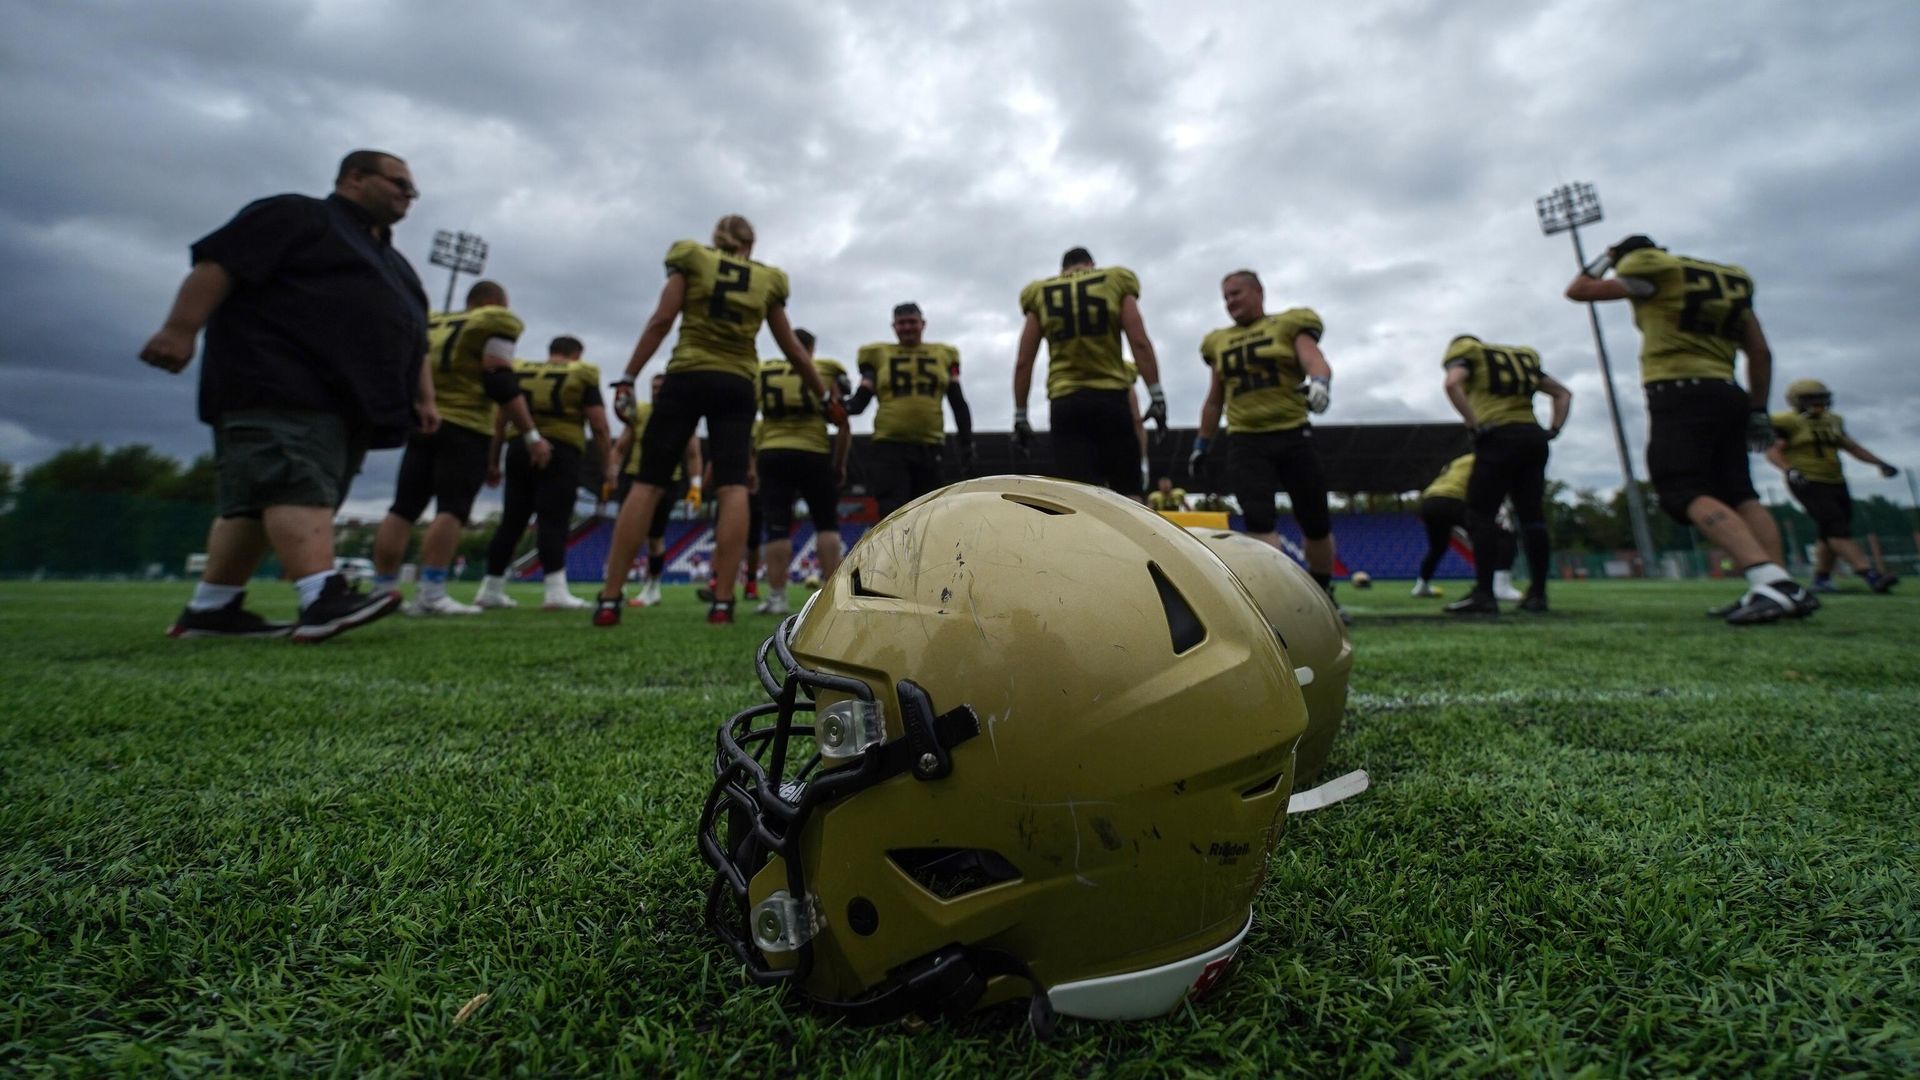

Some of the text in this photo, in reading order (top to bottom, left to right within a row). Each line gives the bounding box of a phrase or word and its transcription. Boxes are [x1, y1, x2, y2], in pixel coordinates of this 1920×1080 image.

[709, 260, 751, 325] 2
[1044, 275, 1108, 341] 96
[429, 319, 466, 373] 7
[891, 357, 938, 397] 65
